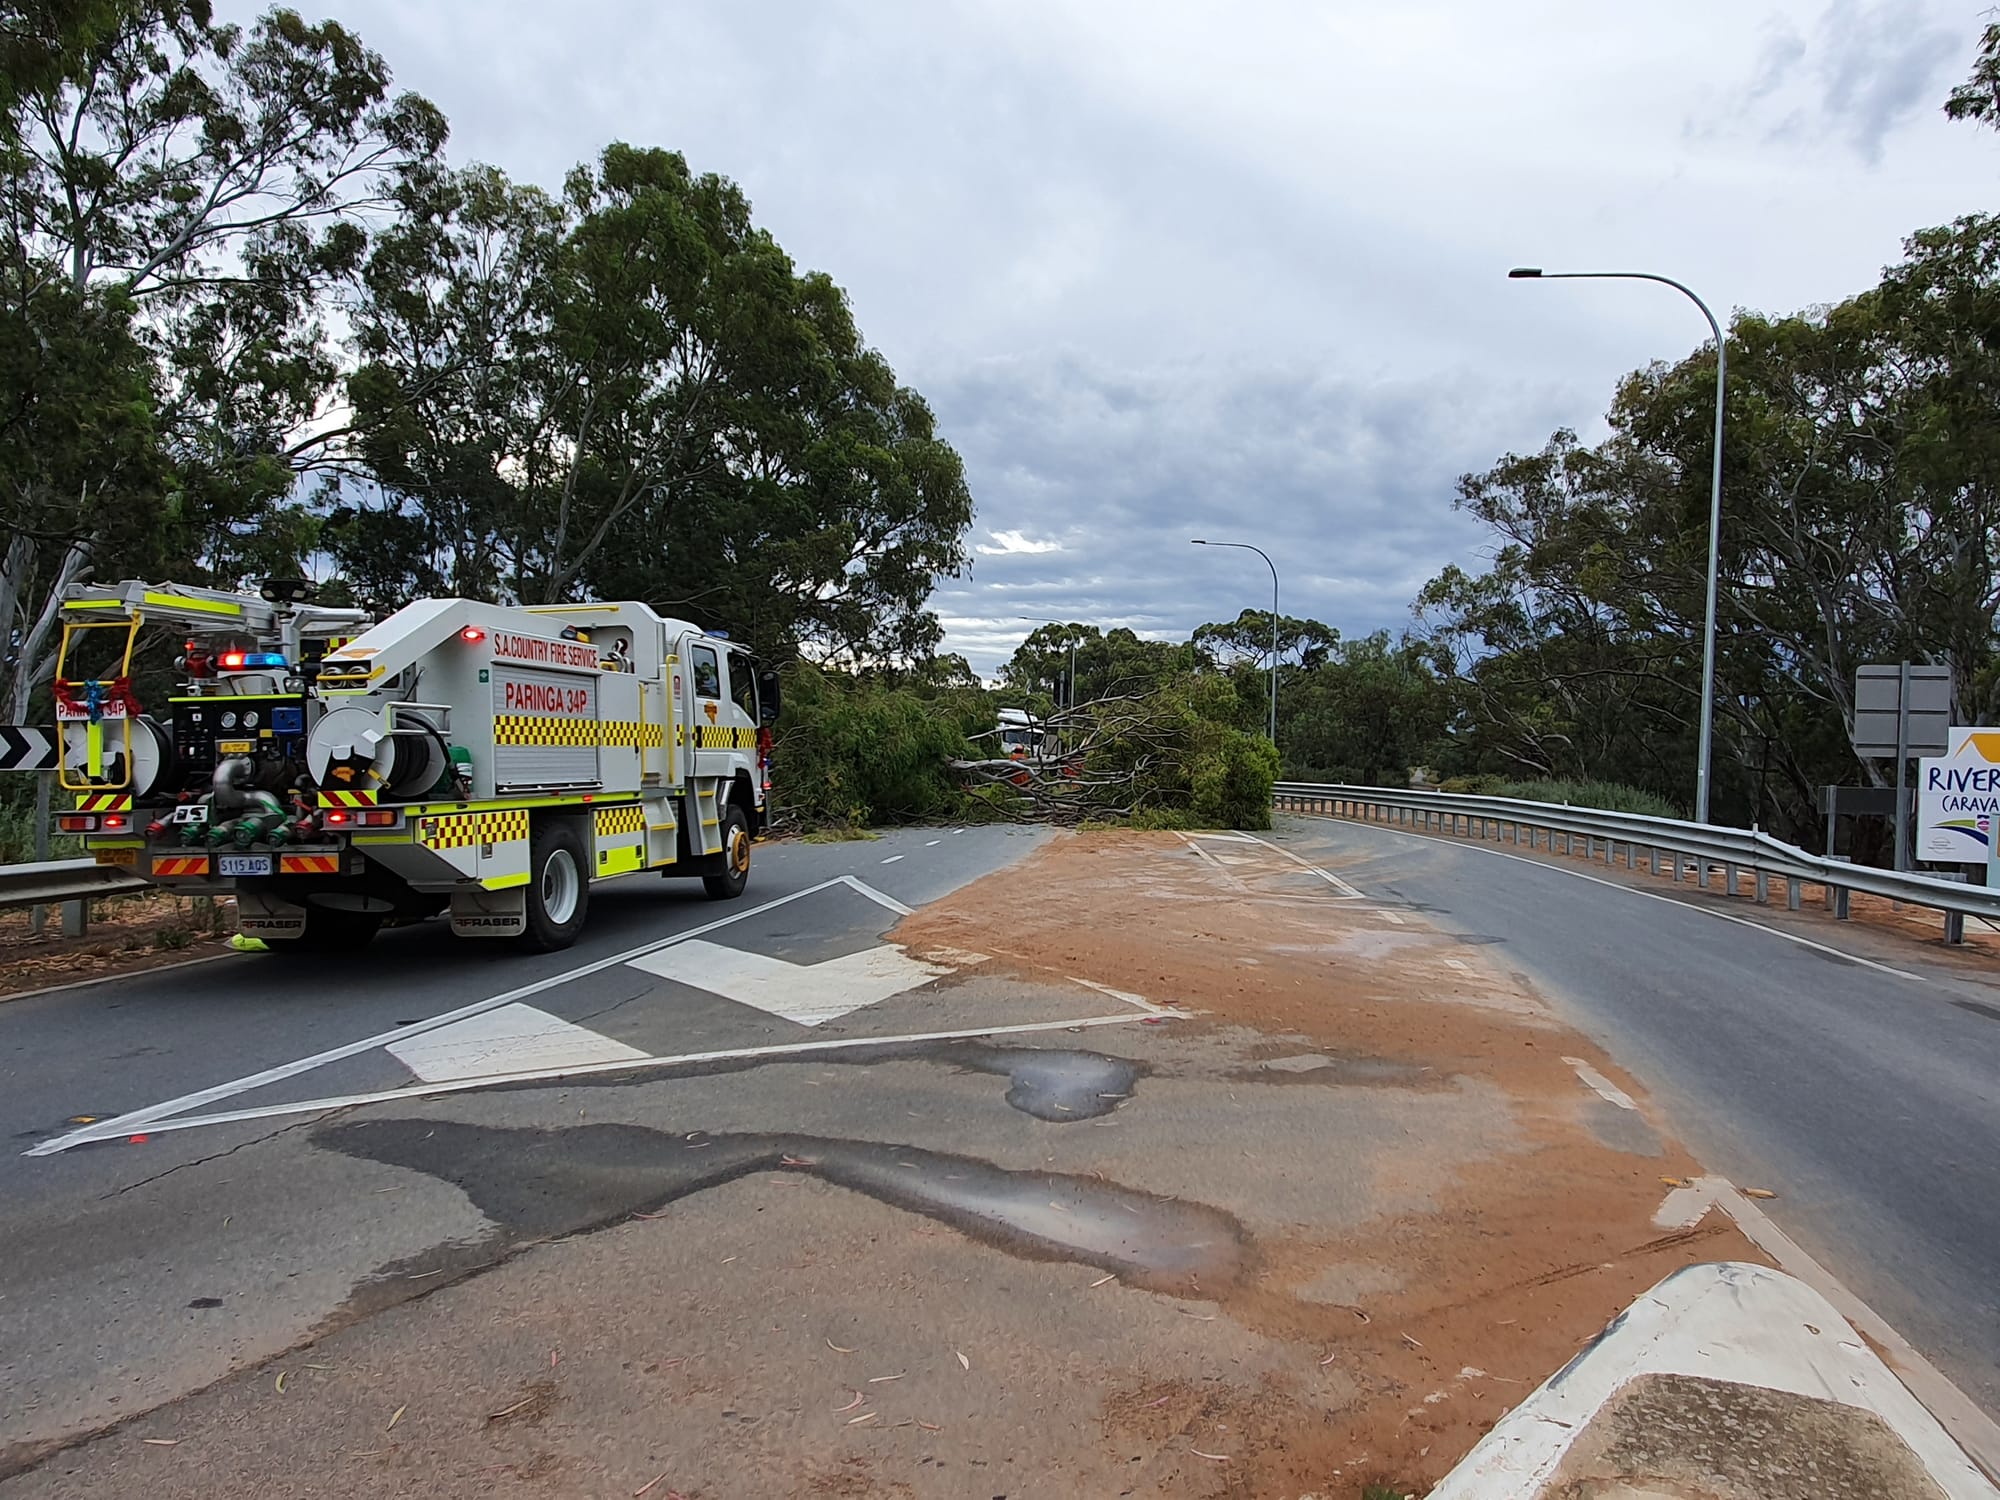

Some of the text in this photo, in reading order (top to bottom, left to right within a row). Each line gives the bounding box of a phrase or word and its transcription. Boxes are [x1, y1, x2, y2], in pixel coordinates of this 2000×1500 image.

[550, 643, 568, 665] FIRE
[568, 646, 598, 669] SERVICE
[505, 682, 588, 714] PARINGA 34P
[1928, 767, 2000, 793] RIVER
[1942, 795, 2000, 813] CARAVA
